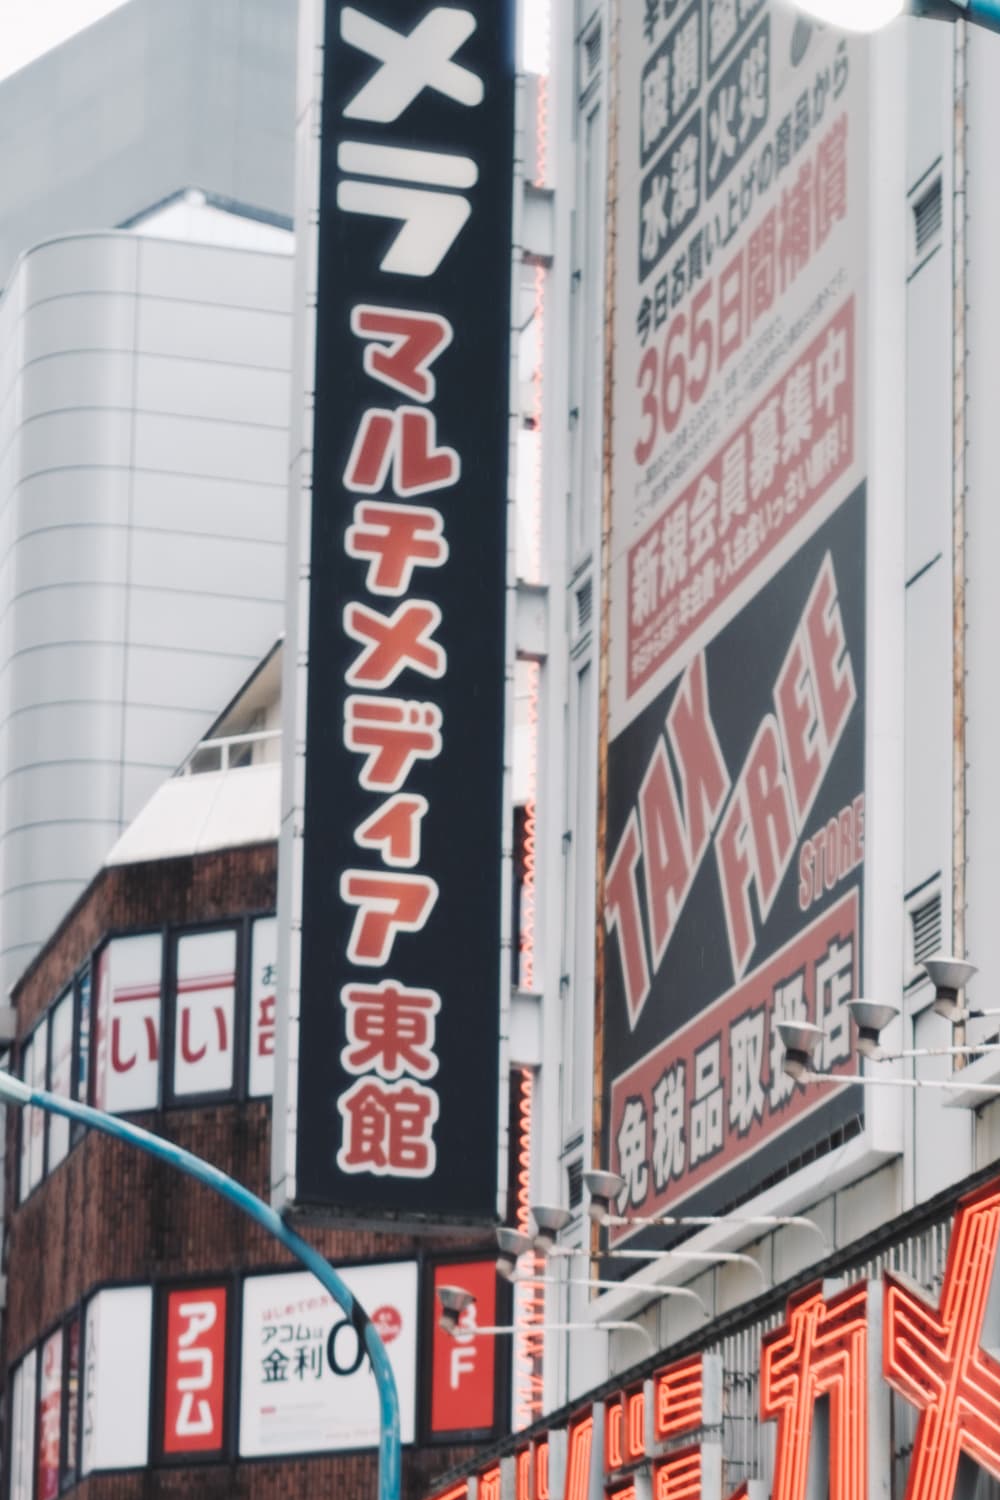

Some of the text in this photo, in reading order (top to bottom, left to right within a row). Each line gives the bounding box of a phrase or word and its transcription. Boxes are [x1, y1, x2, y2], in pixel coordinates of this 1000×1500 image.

[631, 325, 847, 626] 新規会員募集中
[605, 550, 856, 1033] TAX FREE
[799, 793, 866, 911] STORE
[175, 1300, 218, 1438] アコム
